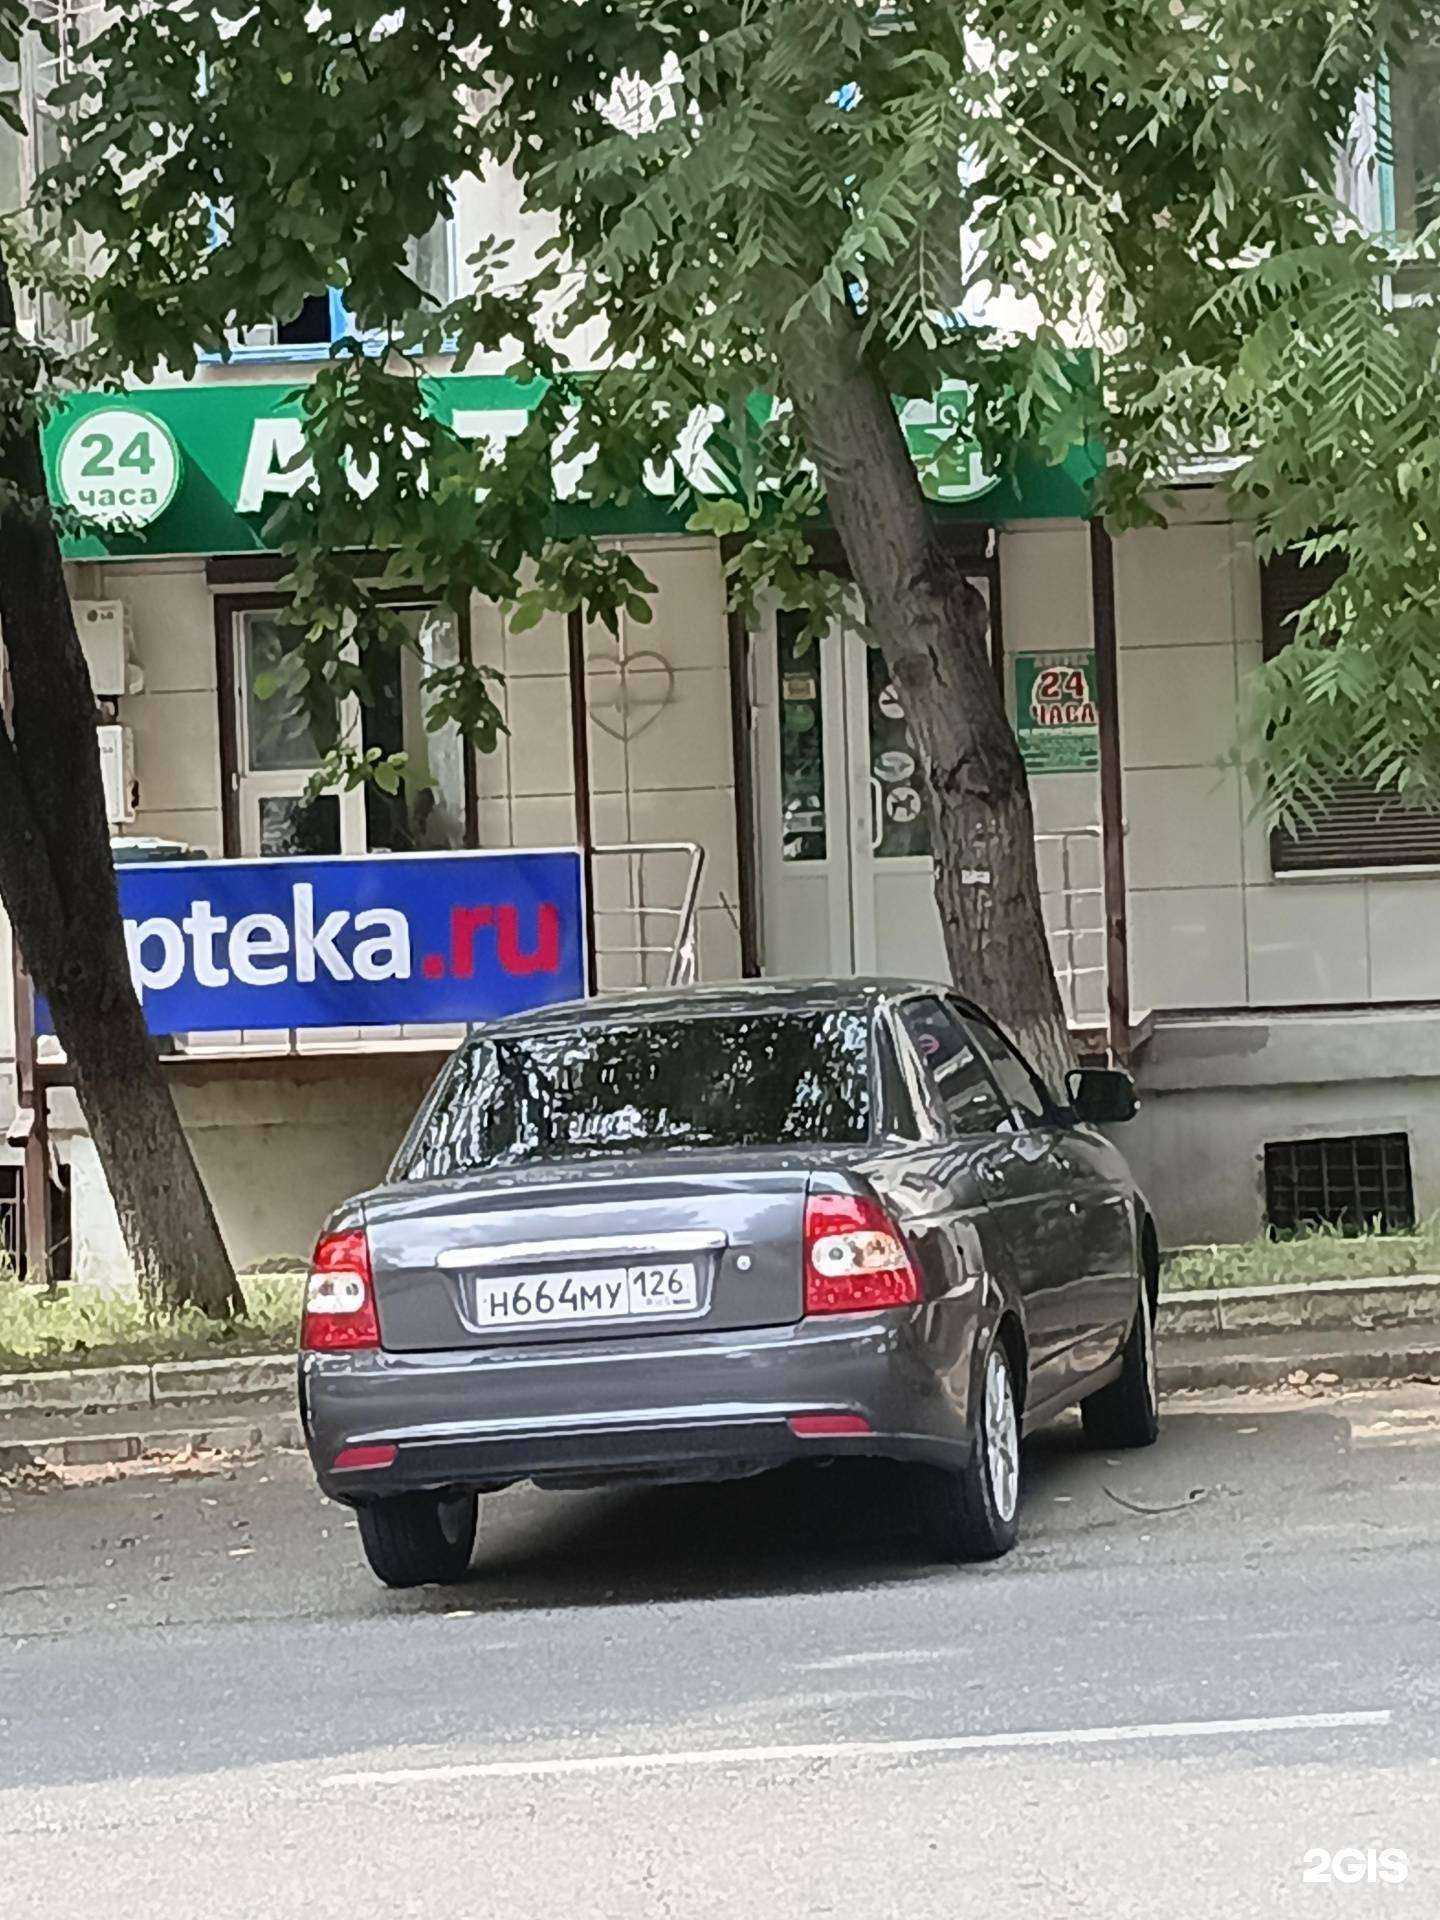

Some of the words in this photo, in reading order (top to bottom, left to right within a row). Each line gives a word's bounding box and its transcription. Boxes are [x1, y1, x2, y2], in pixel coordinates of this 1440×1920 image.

[80, 431, 156, 477] 24
[78, 488, 157, 506] часа
[1040, 670, 1085, 699] 24
[1030, 703, 1096, 725] ЧАСА
[123, 882, 560, 1007] pteka.ru
[489, 1278, 622, 1317] Н664МУ
[632, 1268, 684, 1298] 126
